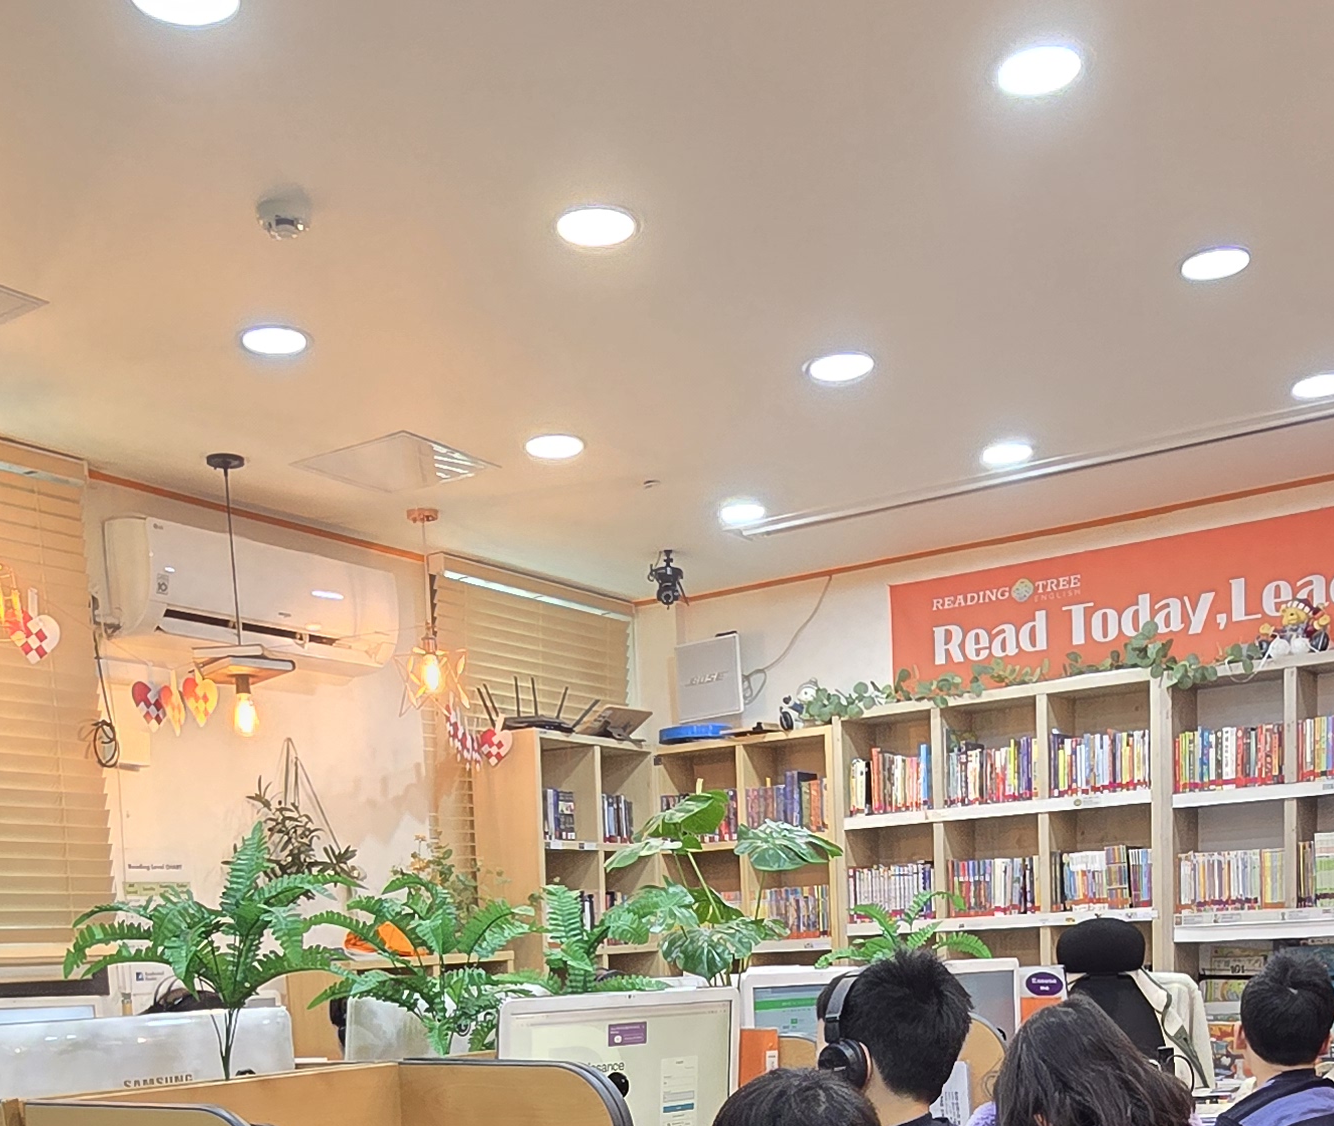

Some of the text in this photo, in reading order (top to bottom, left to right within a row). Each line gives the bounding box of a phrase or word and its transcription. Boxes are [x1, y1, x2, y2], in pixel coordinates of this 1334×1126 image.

[932, 574, 1081, 610] READING TREE
[1034, 589, 1081, 603] ENGLISH
[933, 610, 1047, 665] Read
